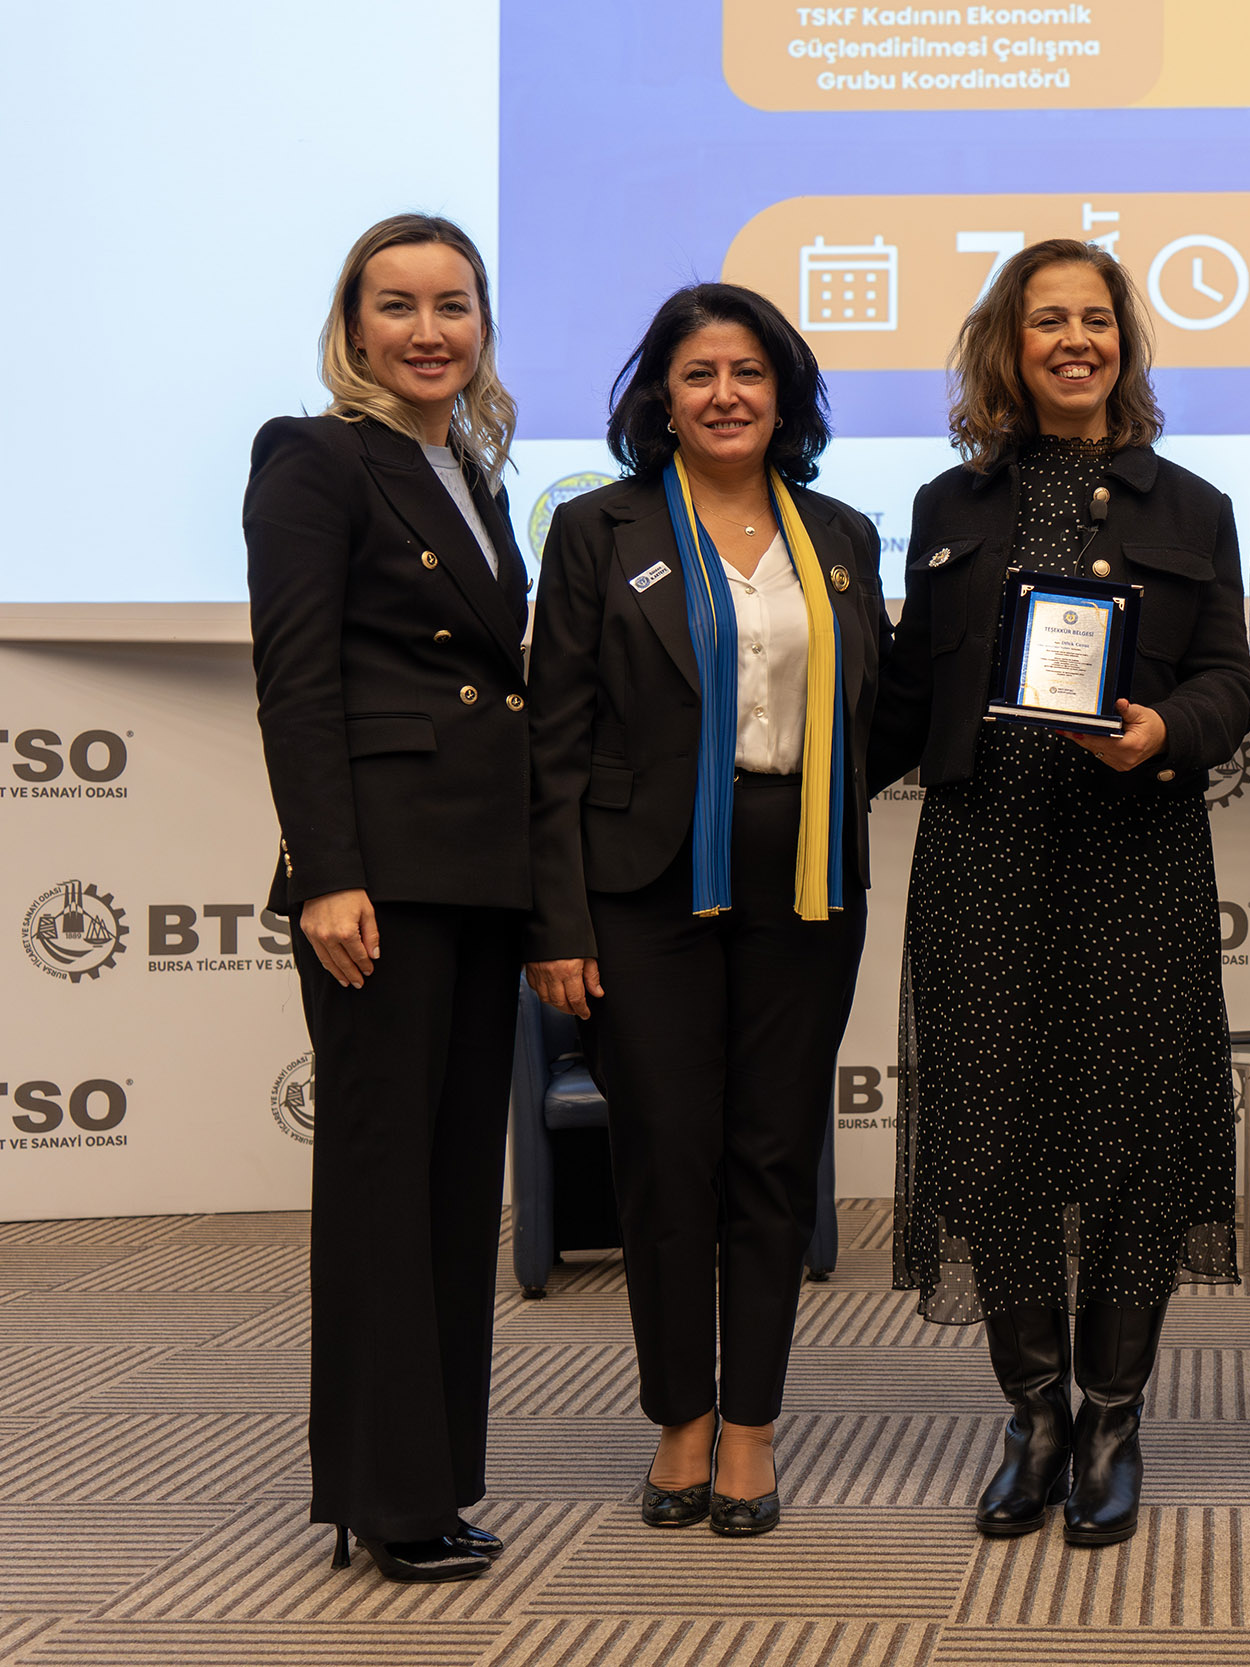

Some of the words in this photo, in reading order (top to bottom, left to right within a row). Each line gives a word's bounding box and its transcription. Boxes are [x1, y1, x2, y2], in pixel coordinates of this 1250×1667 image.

[797, 7, 857, 26] TSKF
[862, 6, 961, 26] Kadının
[967, 4, 1091, 25] Ekonomik
[788, 36, 988, 63] Güçlendirilmesi
[993, 36, 1100, 62] Çalışma
[817, 69, 896, 90] Grubu
[901, 69, 1071, 90] Koordinatörü
[0, 729, 127, 782] SO
[10, 787, 28, 798] VE
[31, 785, 82, 798] SANAYİ
[85, 787, 128, 798] ODASI
[882, 788, 925, 801] TİCARE
[148, 904, 293, 956] BTS
[148, 961, 193, 972] BURSA
[197, 958, 253, 971] TİCARET
[256, 959, 273, 970] VE
[1222, 954, 1249, 965] DASI
[0, 1079, 127, 1133] SO
[838, 1118, 878, 1129] BURSA
[9, 1139, 28, 1150] VE
[31, 1135, 82, 1149] SANAYİ
[85, 1135, 128, 1147] ODASI
